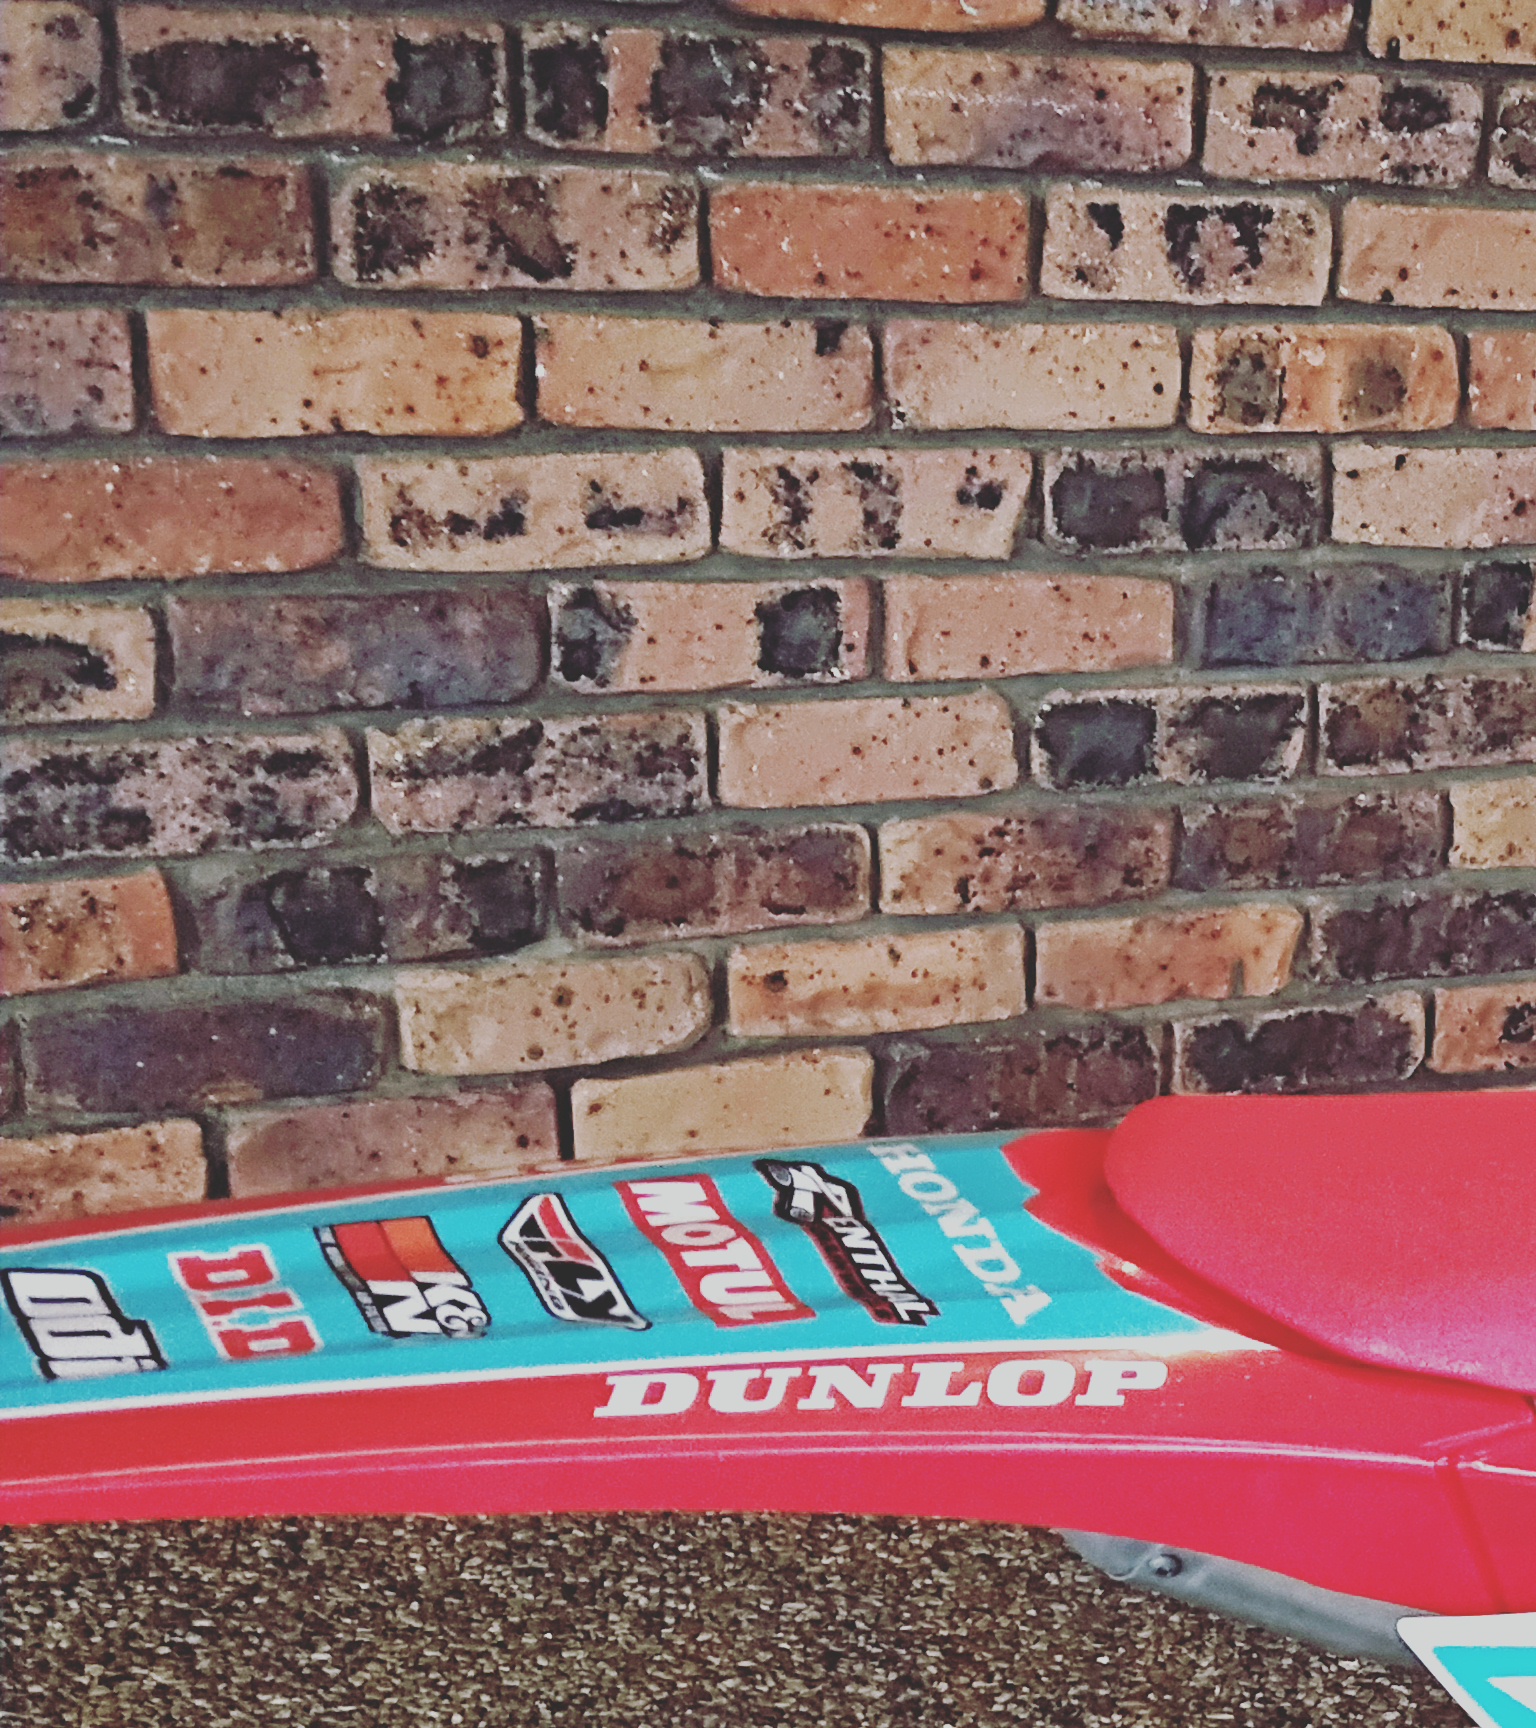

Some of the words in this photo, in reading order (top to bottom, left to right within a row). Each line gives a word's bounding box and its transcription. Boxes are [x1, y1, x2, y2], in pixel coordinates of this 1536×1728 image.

[627, 1180, 798, 1322] MOTUL
[867, 1142, 1053, 1326] HONDA
[593, 1358, 1169, 1418] DUNLOP
